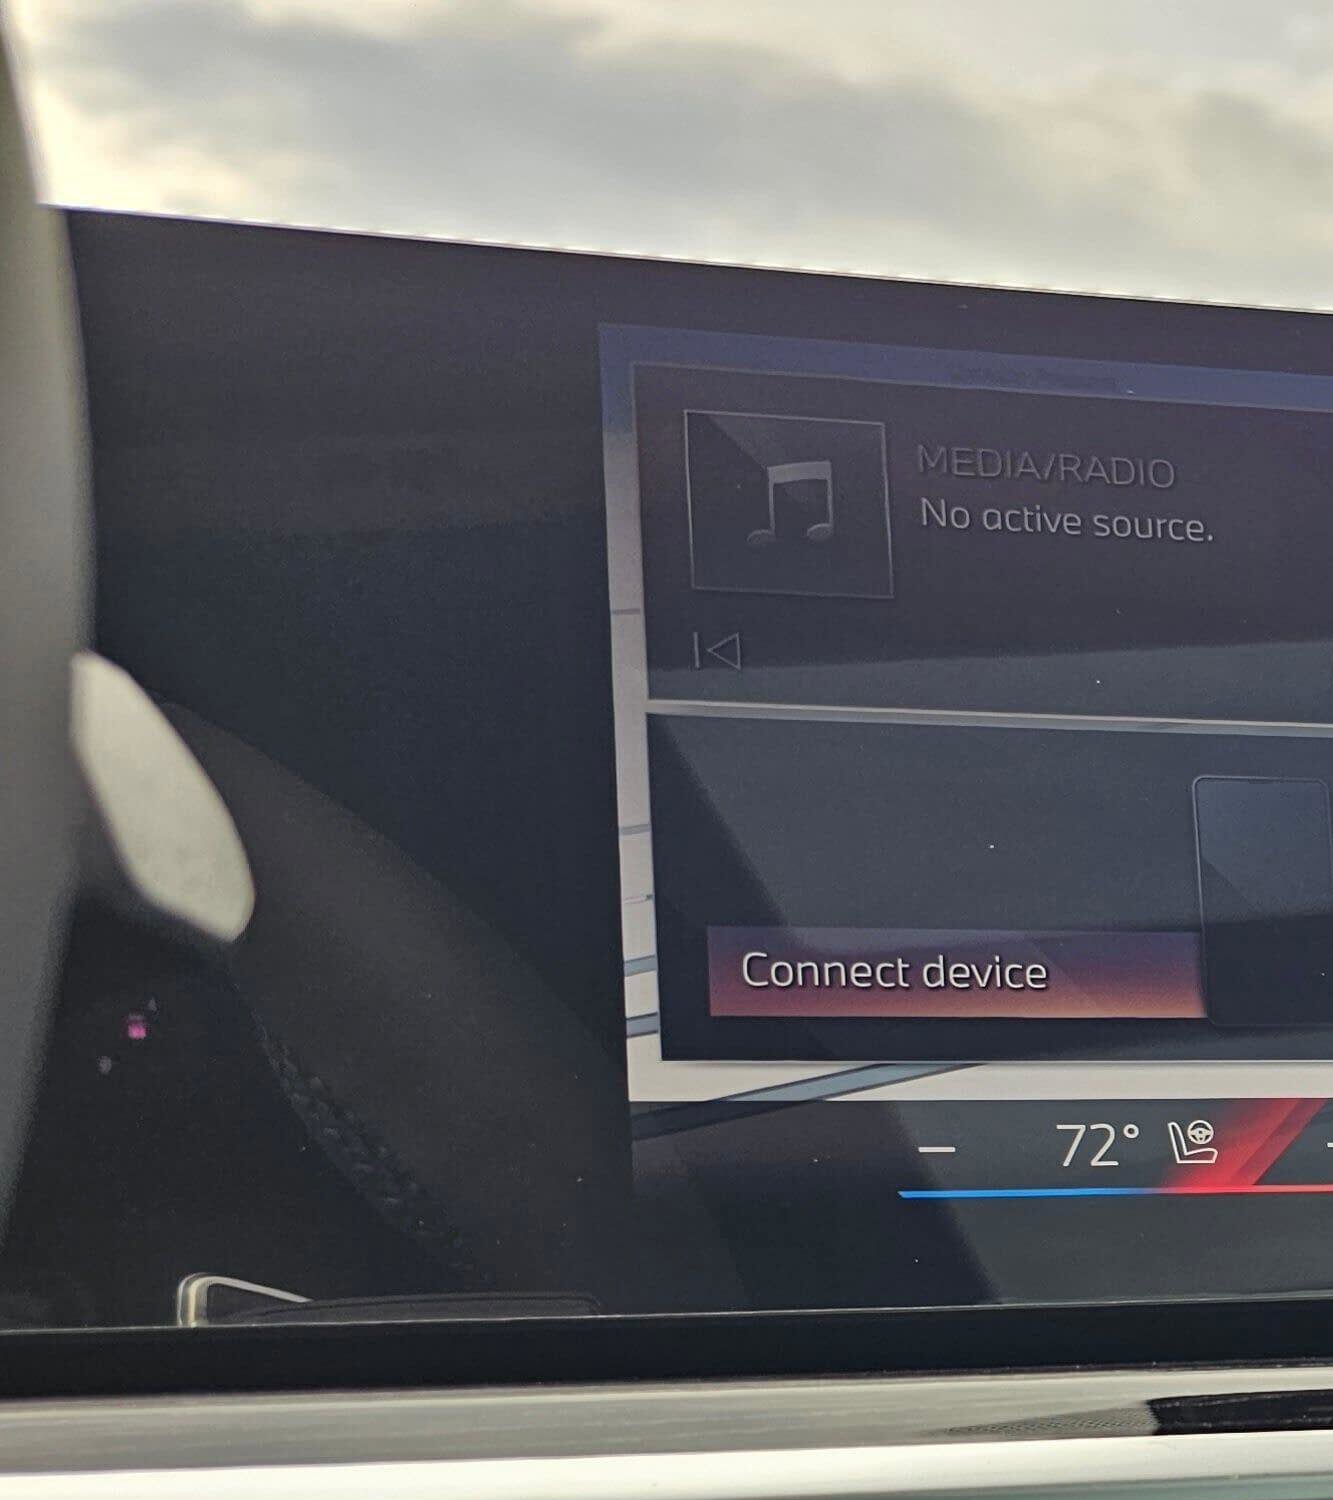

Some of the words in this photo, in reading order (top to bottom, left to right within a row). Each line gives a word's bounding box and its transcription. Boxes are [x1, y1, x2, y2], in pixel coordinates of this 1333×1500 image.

[917, 444, 1175, 489] MEDIA/RADIO
[920, 496, 971, 530] No
[981, 503, 1082, 537] active
[1093, 510, 1215, 544] source.
[741, 951, 911, 990] Connect
[921, 953, 1048, 990] device
